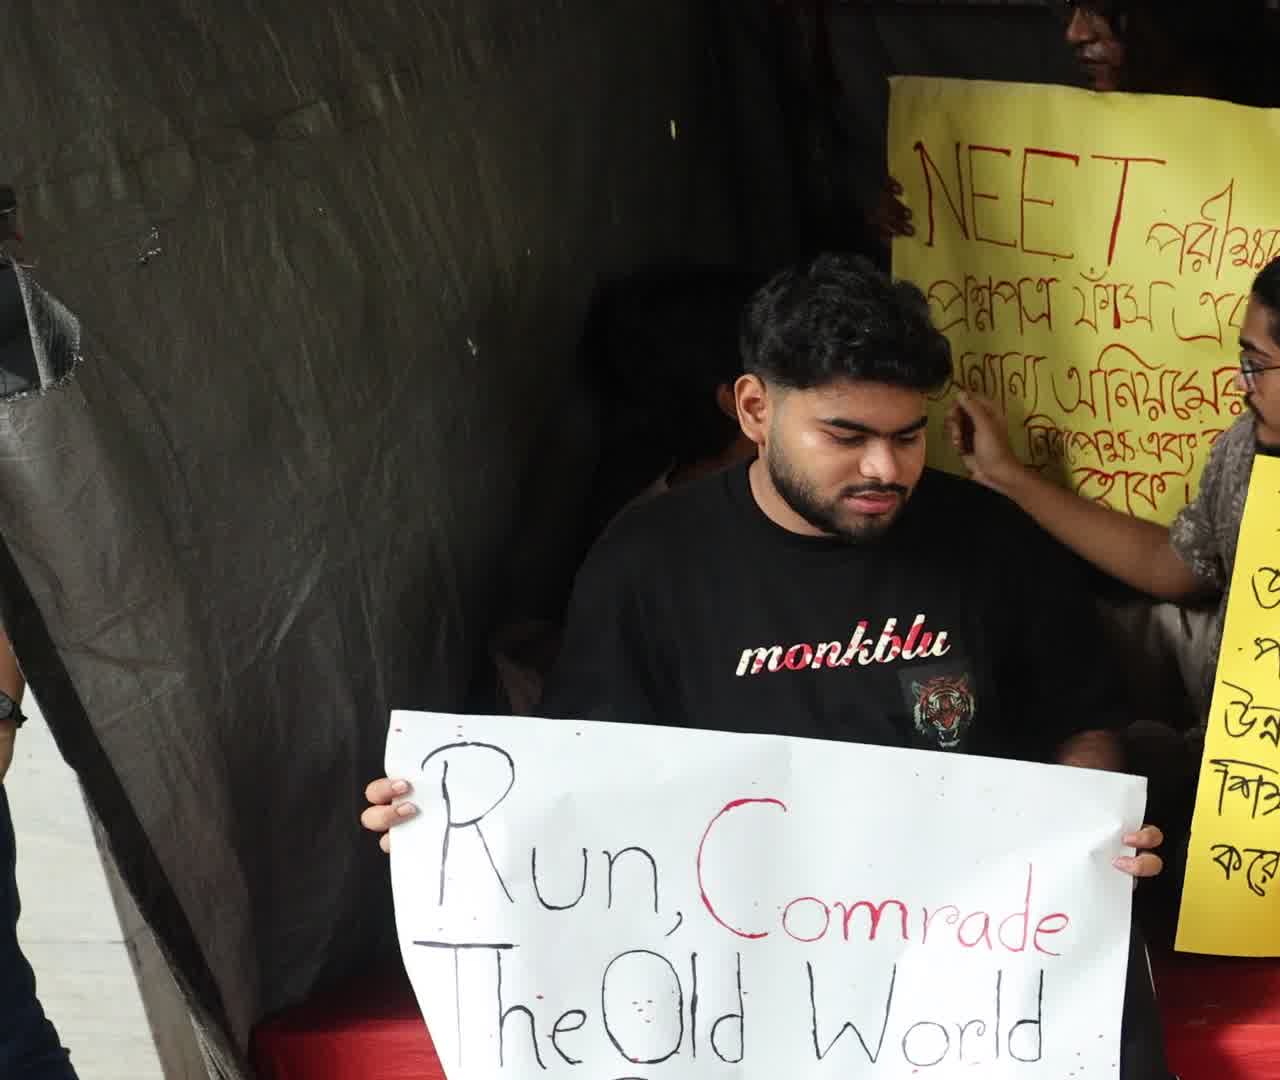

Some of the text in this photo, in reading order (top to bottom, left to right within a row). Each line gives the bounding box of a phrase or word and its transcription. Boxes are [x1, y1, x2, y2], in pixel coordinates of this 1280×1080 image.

[914, 141, 1166, 266] NEET
[735, 613, 951, 677] monkblu
[421, 742, 1071, 957] Run, Comrade
[806, 961, 1045, 1067] World
